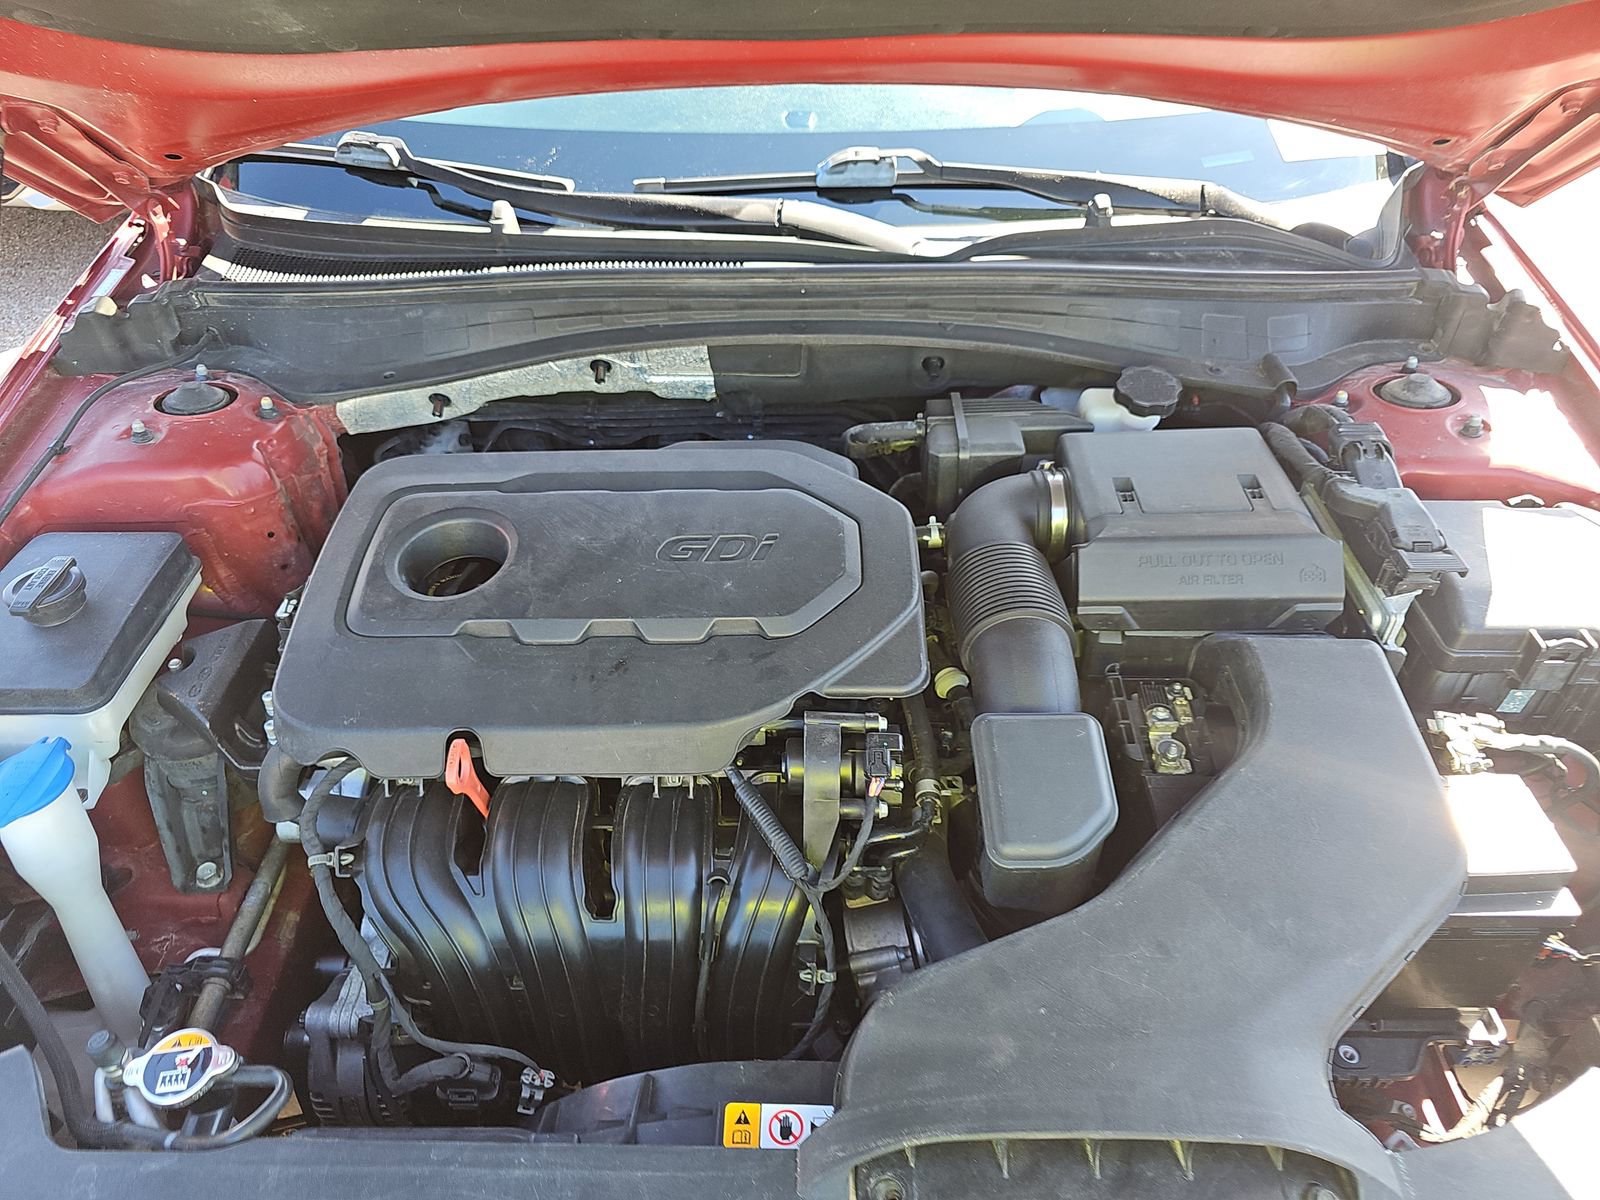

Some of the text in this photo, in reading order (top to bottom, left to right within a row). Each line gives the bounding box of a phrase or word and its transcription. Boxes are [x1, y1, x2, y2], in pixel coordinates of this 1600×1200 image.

[1137, 551, 1284, 568] PULL OUT TO OPEN
[1178, 573, 1244, 586] AIR FILTER
